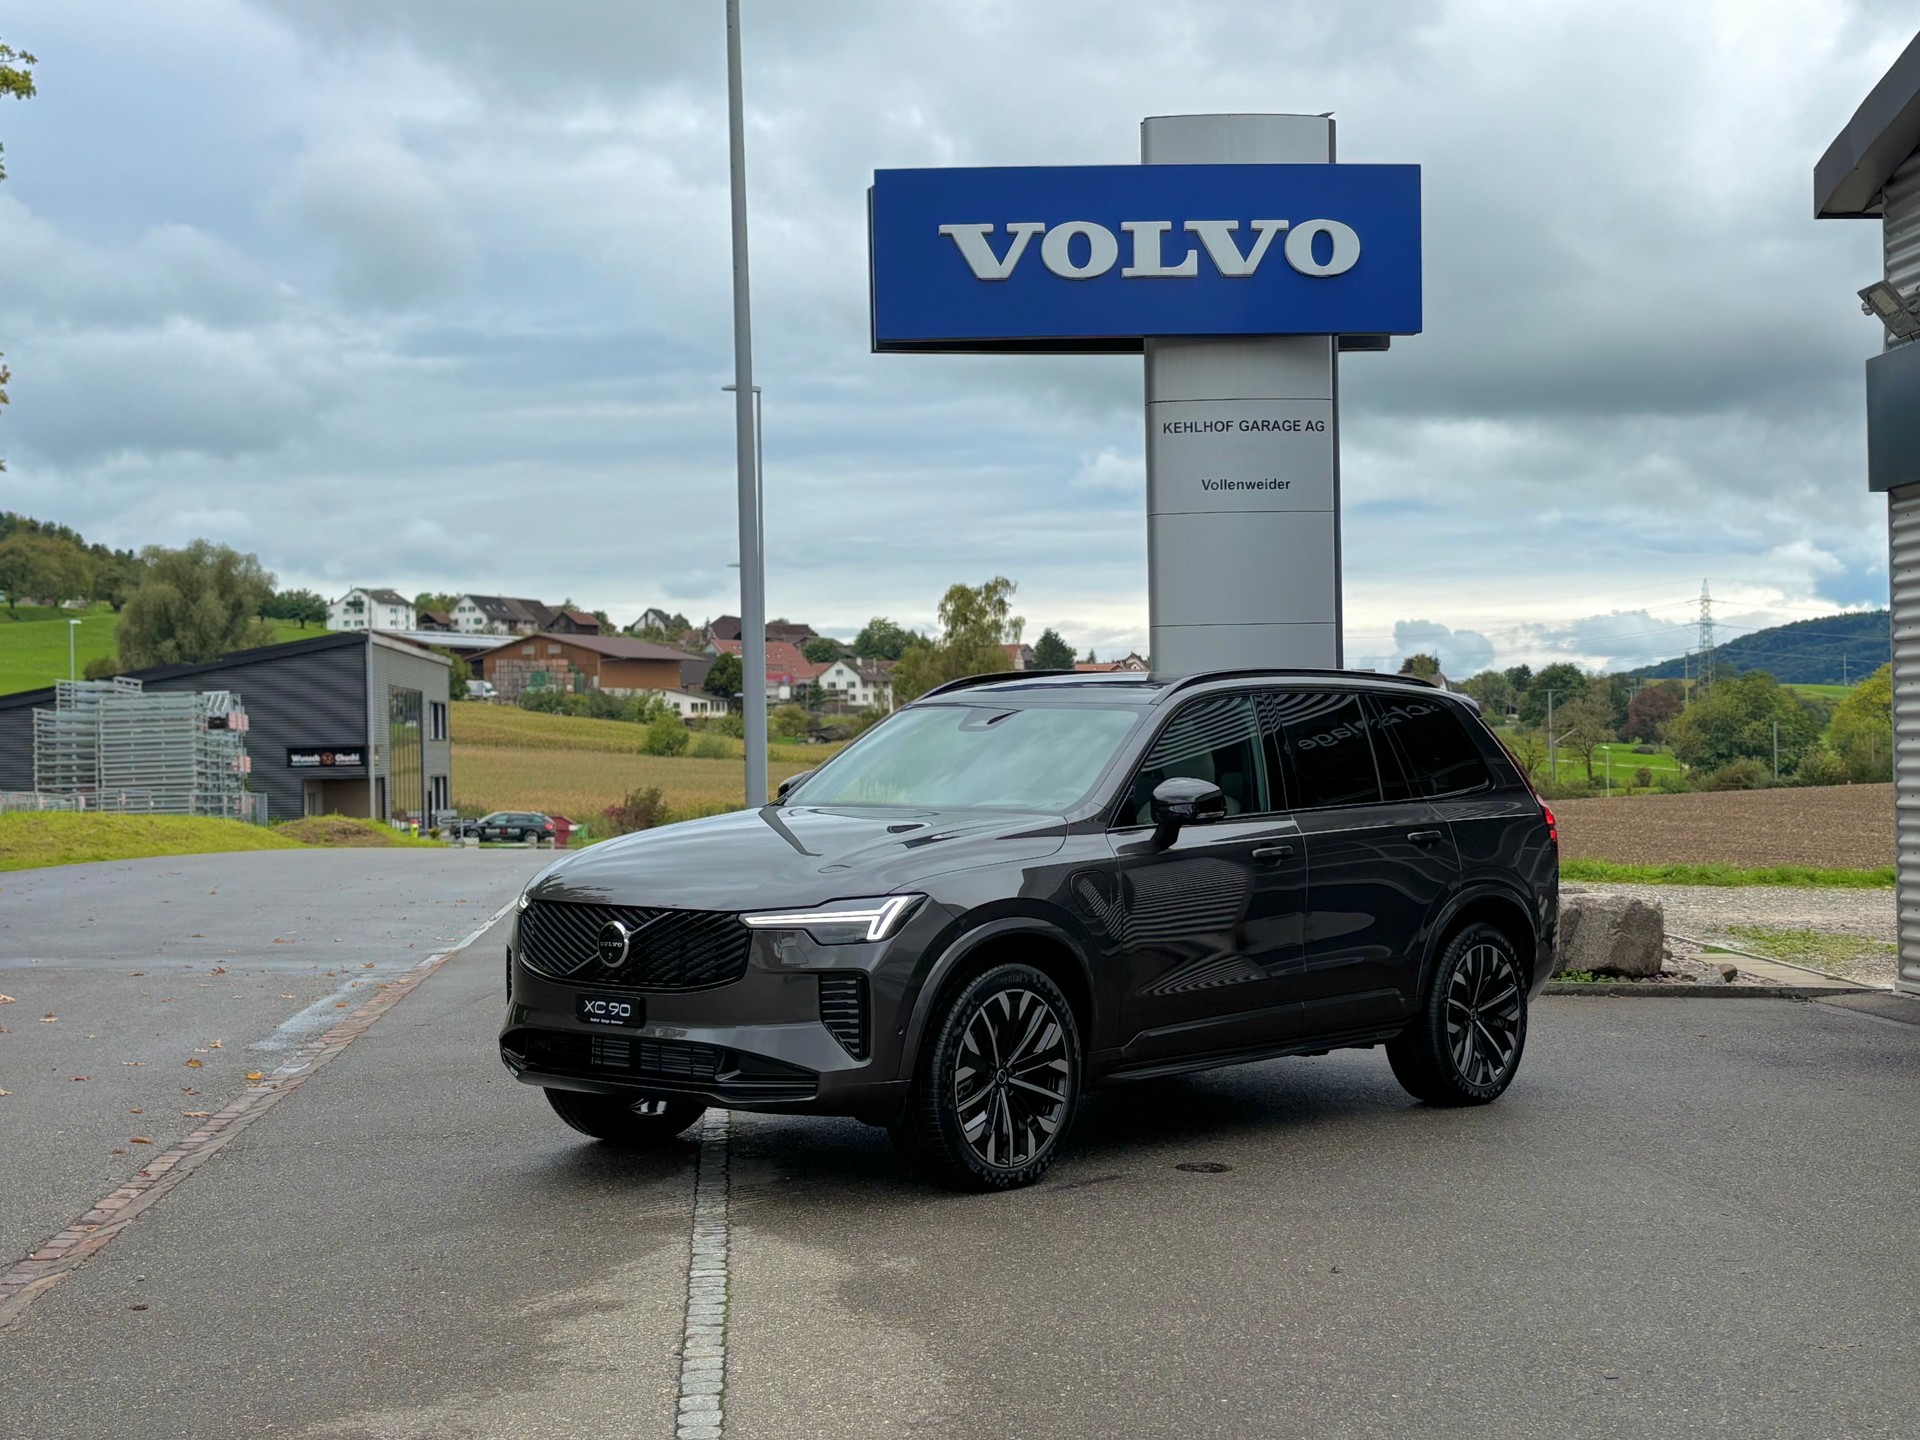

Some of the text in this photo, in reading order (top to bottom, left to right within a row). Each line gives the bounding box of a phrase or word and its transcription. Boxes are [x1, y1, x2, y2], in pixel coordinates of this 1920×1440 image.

[938, 218, 1361, 281] VOLVO
[1163, 420, 1325, 434] KEHLHOF GARAGE AG
[1201, 479, 1291, 491] Vollenweider
[584, 1000, 631, 1017] XC90
